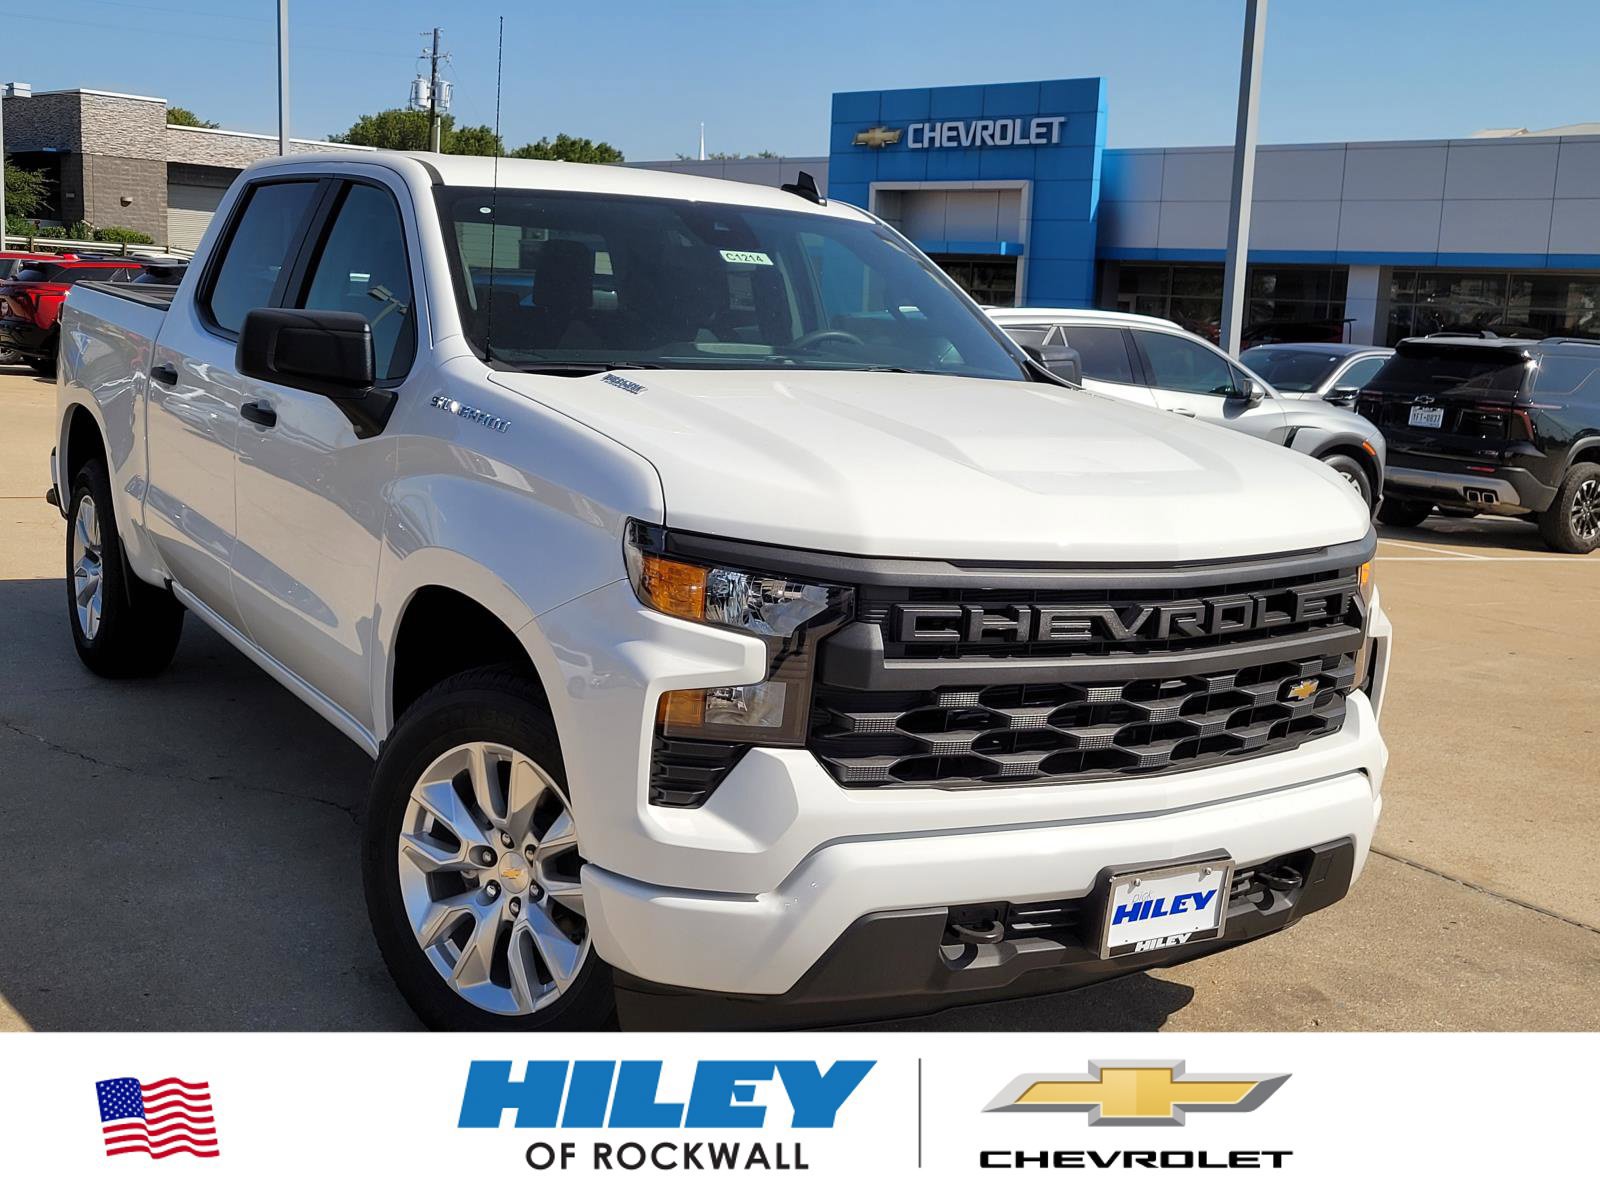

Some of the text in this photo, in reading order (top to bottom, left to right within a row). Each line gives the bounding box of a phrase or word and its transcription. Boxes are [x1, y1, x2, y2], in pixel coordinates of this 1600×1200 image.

[907, 117, 1066, 149] CHEVROLET
[724, 252, 765, 263] C1214
[430, 395, 512, 434] SILERADO
[896, 583, 1358, 642] CHEVROLET
[1112, 889, 1218, 926] HILEY
[1134, 932, 1193, 953] HILEY
